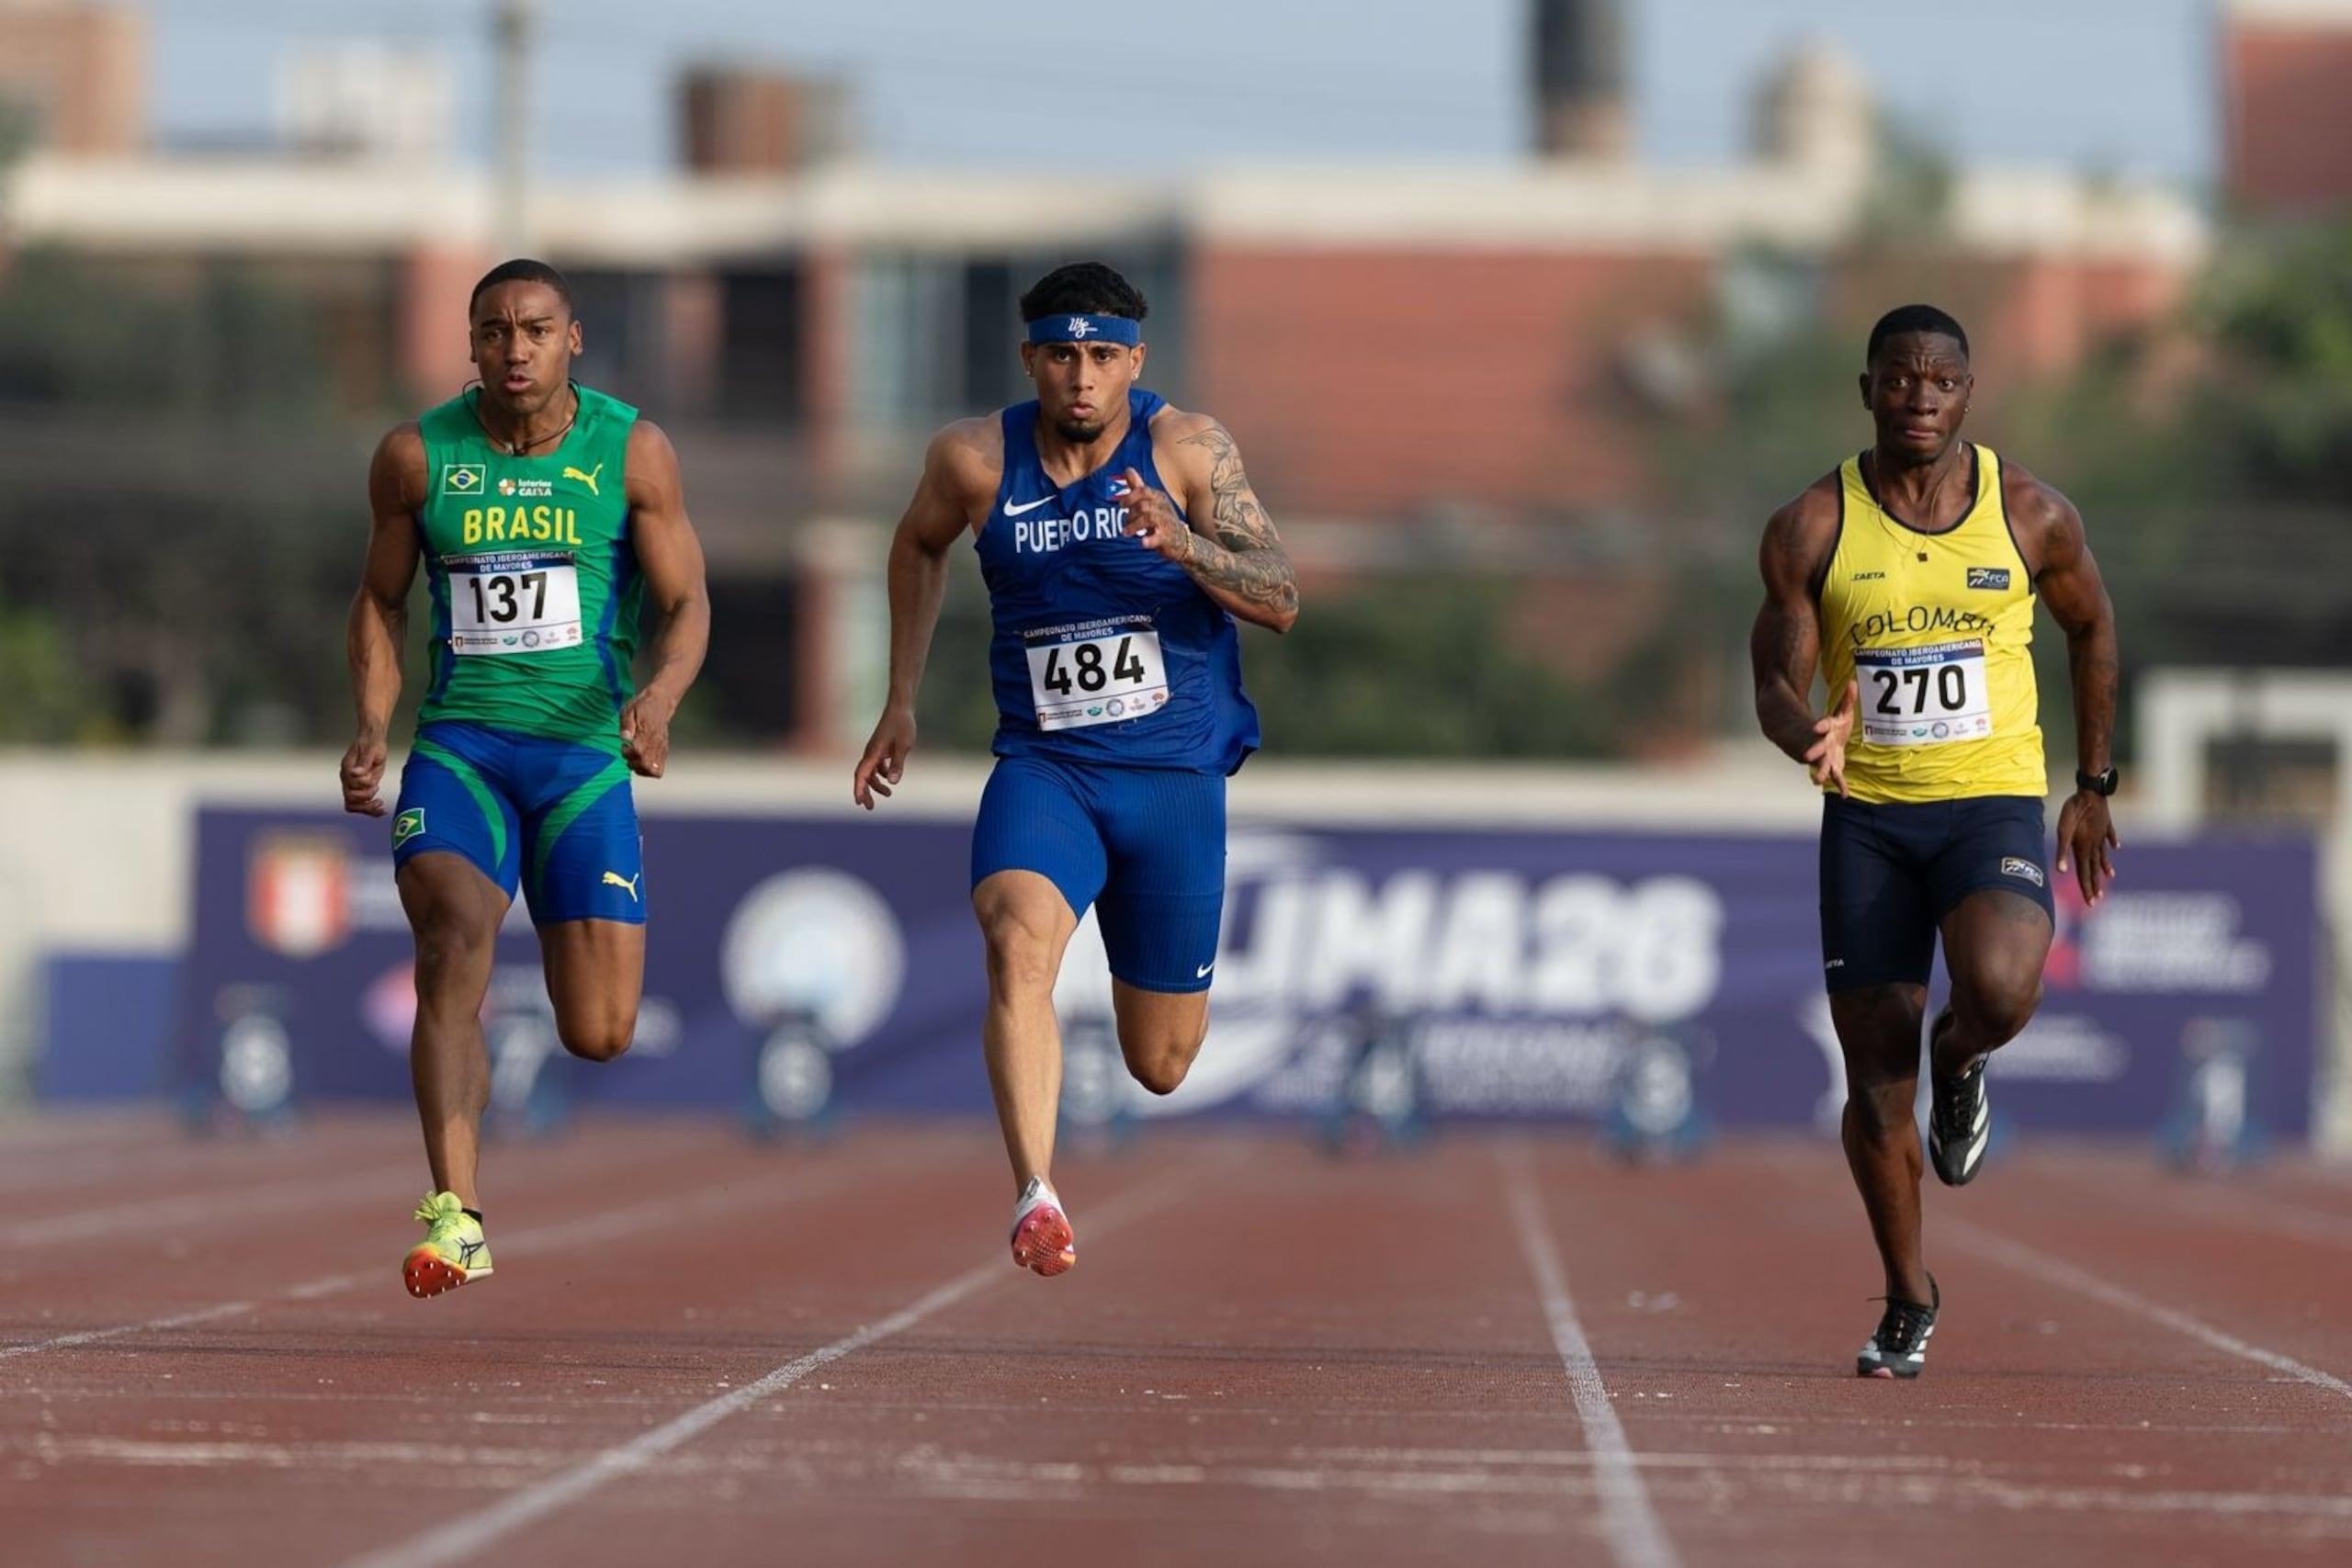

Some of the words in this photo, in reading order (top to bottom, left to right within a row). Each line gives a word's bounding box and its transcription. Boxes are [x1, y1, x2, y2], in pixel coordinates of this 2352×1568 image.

[464, 505, 582, 545] BRASIL
[1015, 510, 1090, 553] PUERO
[1095, 507, 1148, 539] RIC
[480, 564, 491, 572] DE
[493, 561, 532, 570] MAYORES
[469, 571, 547, 624] 137
[1023, 624, 1075, 638] CAMPEONATO
[1077, 615, 1151, 631] IBEROAMERICANO
[1060, 633, 1073, 641] DE
[1074, 626, 1114, 640] MAYORES
[1853, 646, 1907, 658] CAMPEONATO
[1909, 639, 1981, 655] IBEROAMERICANO
[1905, 653, 1944, 664] MAYORES
[1044, 636, 1145, 695] 484
[1872, 664, 1966, 716] 270
